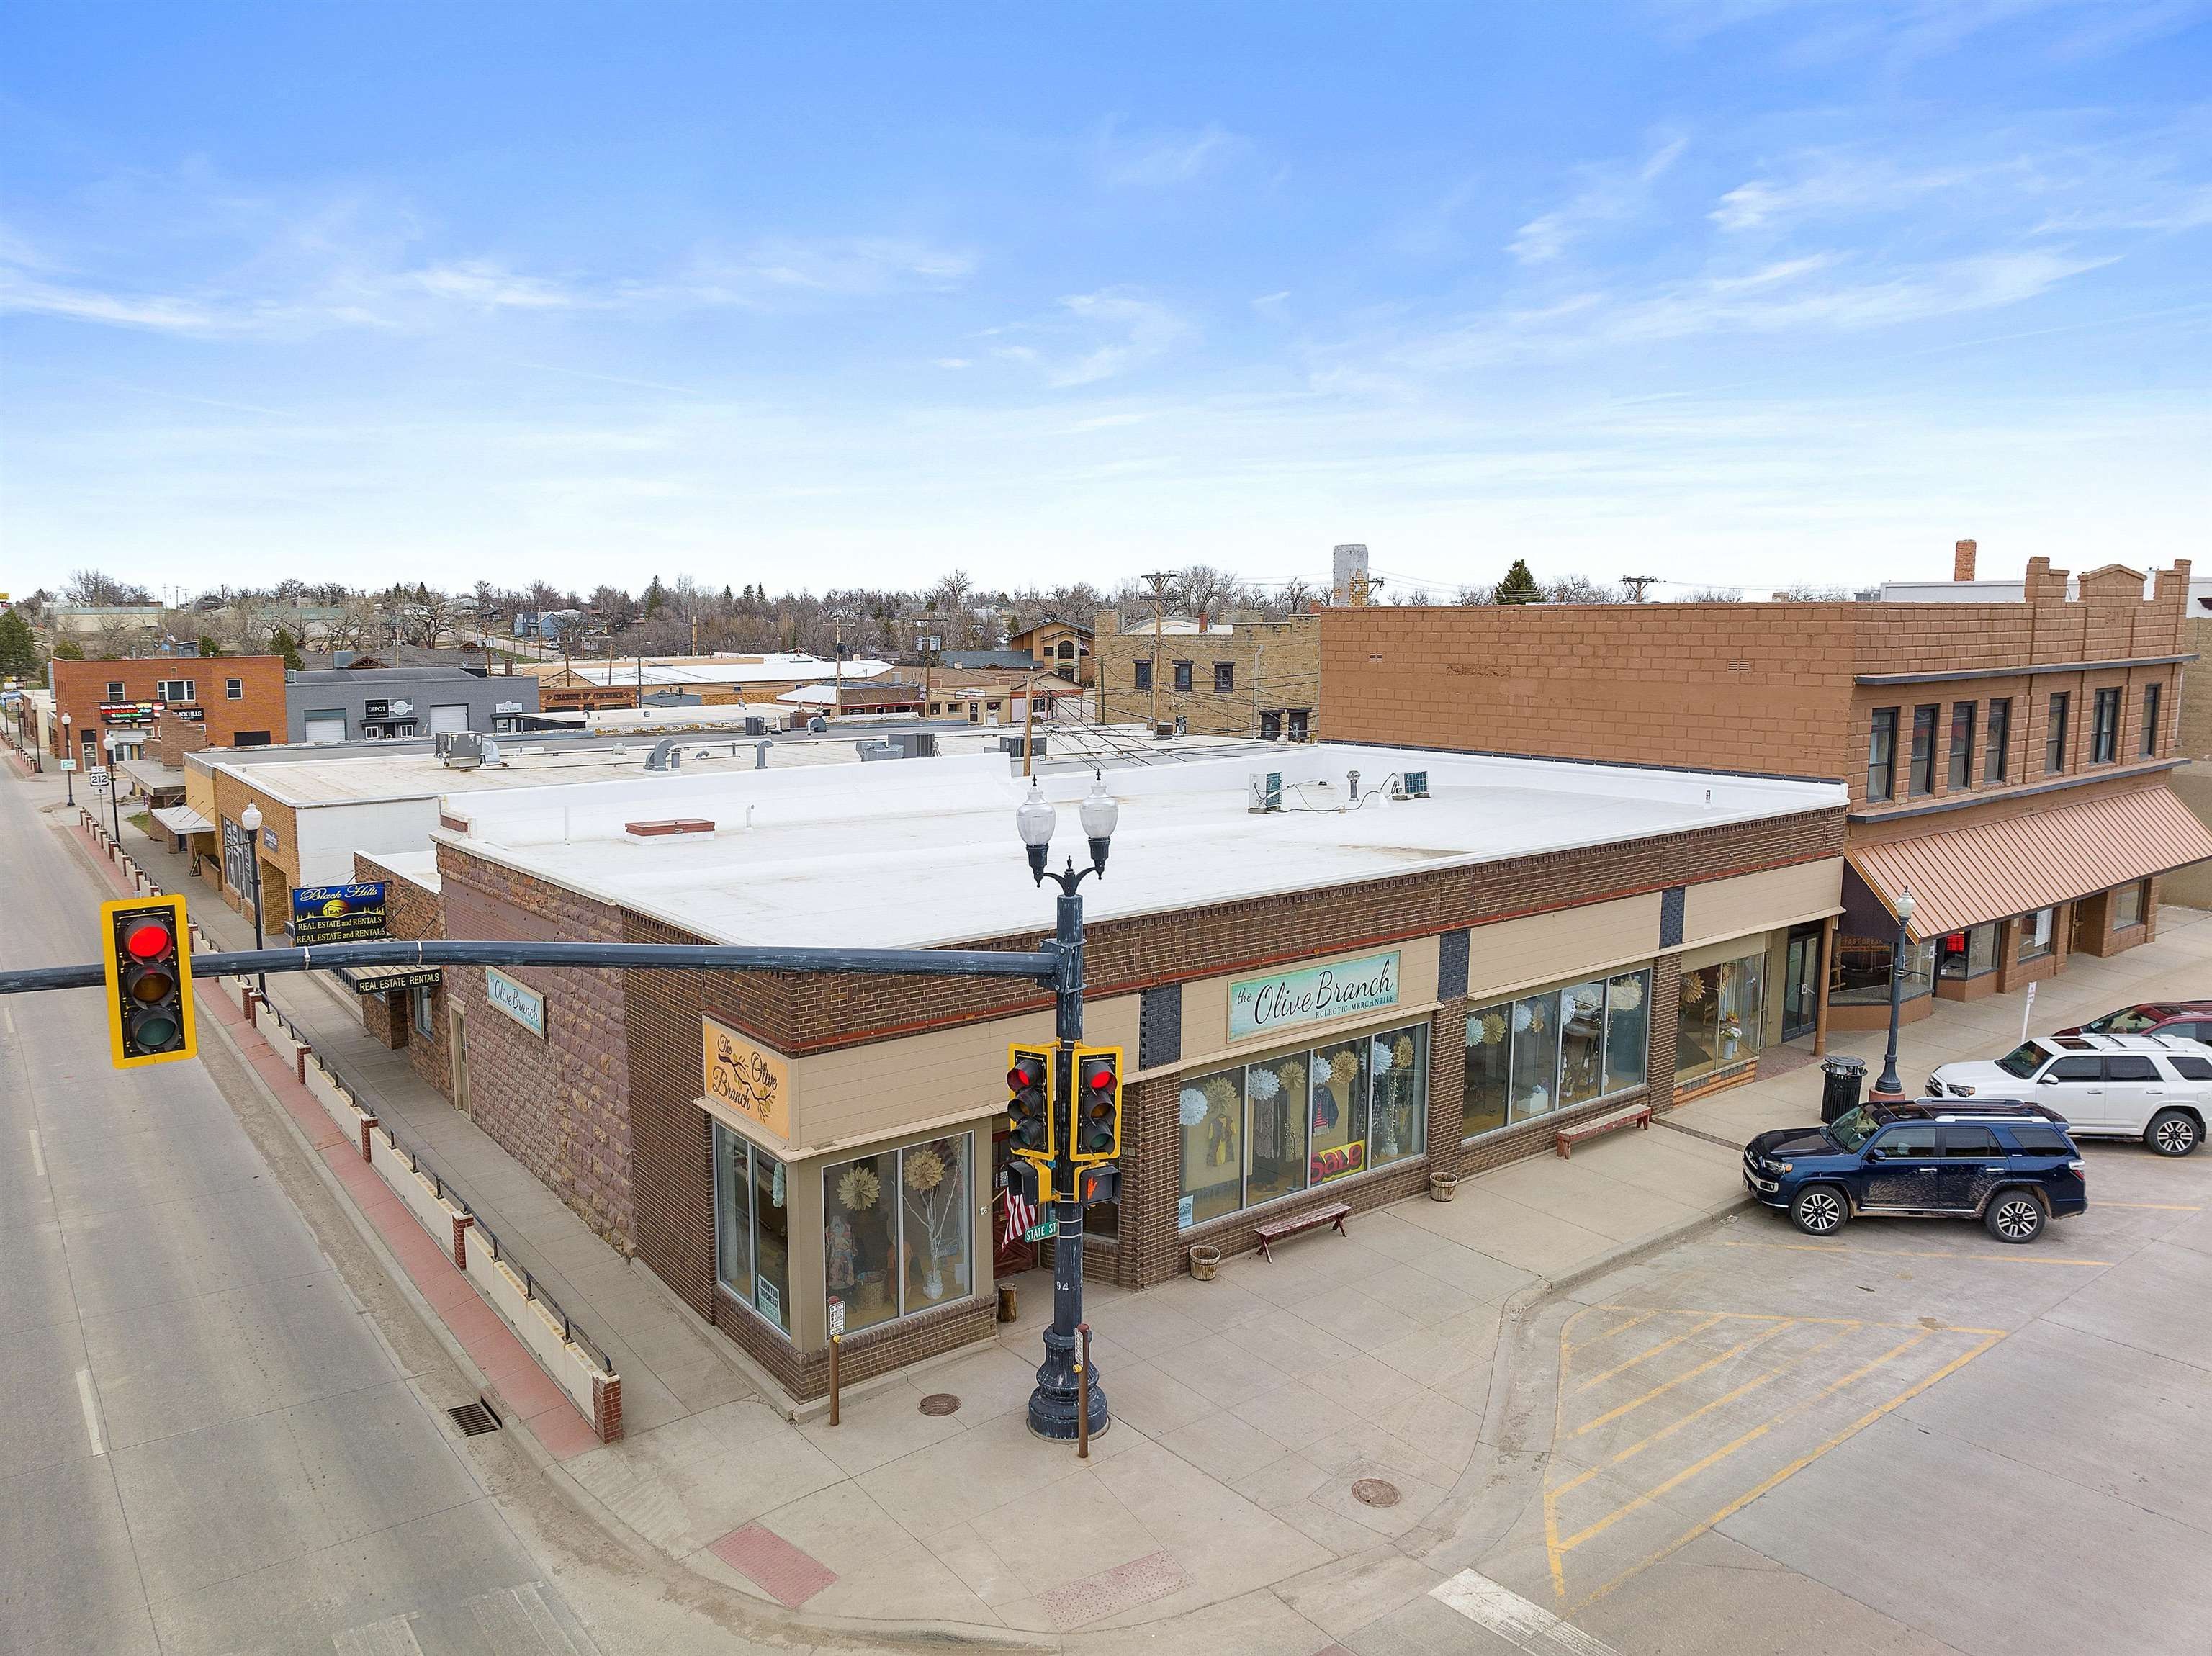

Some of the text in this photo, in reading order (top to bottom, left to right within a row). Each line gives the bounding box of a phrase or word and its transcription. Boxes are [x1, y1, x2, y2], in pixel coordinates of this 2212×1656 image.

[300, 885, 377, 901] Black Hills
[318, 920, 341, 930] ESTATE
[353, 917, 382, 926] RENTALS
[317, 932, 342, 942] ESTATE
[355, 928, 385, 938] RENTALS
[360, 973, 440, 991] REAL ESTATE RENTALS
[1237, 958, 1394, 1025] the Olive Branch
[495, 979, 513, 1007] Olive
[513, 988, 539, 1022] Branch
[1316, 995, 1395, 1019] ECLECTIC MERCANTILE
[750, 1051, 778, 1091] Olive
[712, 1066, 751, 1111] Branch
[1026, 1222, 1057, 1241] STATE ST
